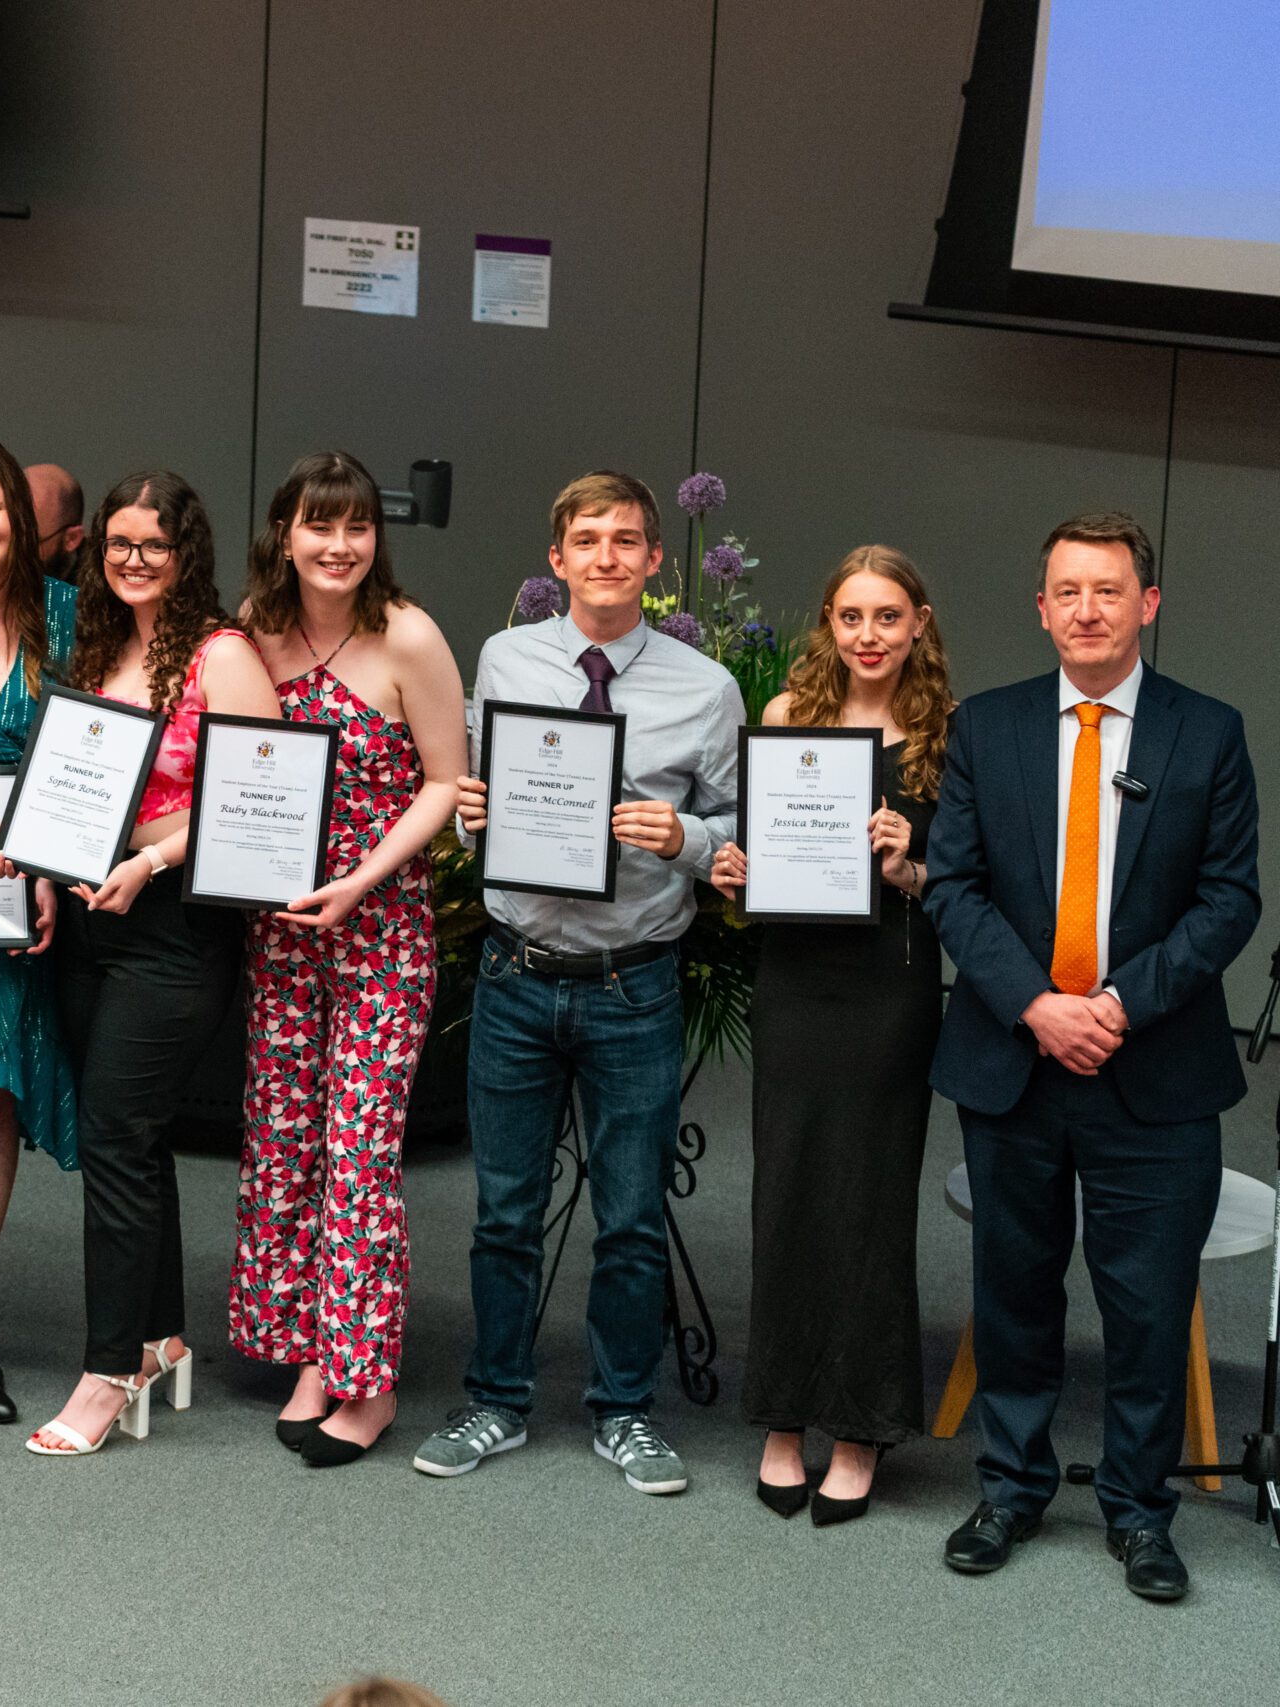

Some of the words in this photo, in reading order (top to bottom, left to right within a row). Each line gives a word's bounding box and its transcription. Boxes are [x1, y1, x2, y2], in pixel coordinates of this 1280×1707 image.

[64, 765, 93, 777] RUNNER
[48, 776, 76, 789] Sophie
[78, 784, 111, 801] Rowley
[528, 780, 561, 789] RUNNER
[240, 792, 273, 800] RUNNER
[505, 792, 537, 802] James
[540, 796, 597, 809] McConnell
[220, 804, 247, 817] Ruby
[251, 808, 307, 821] Blackwood
[771, 818, 807, 827] Jessica
[810, 819, 850, 831] Burgess
